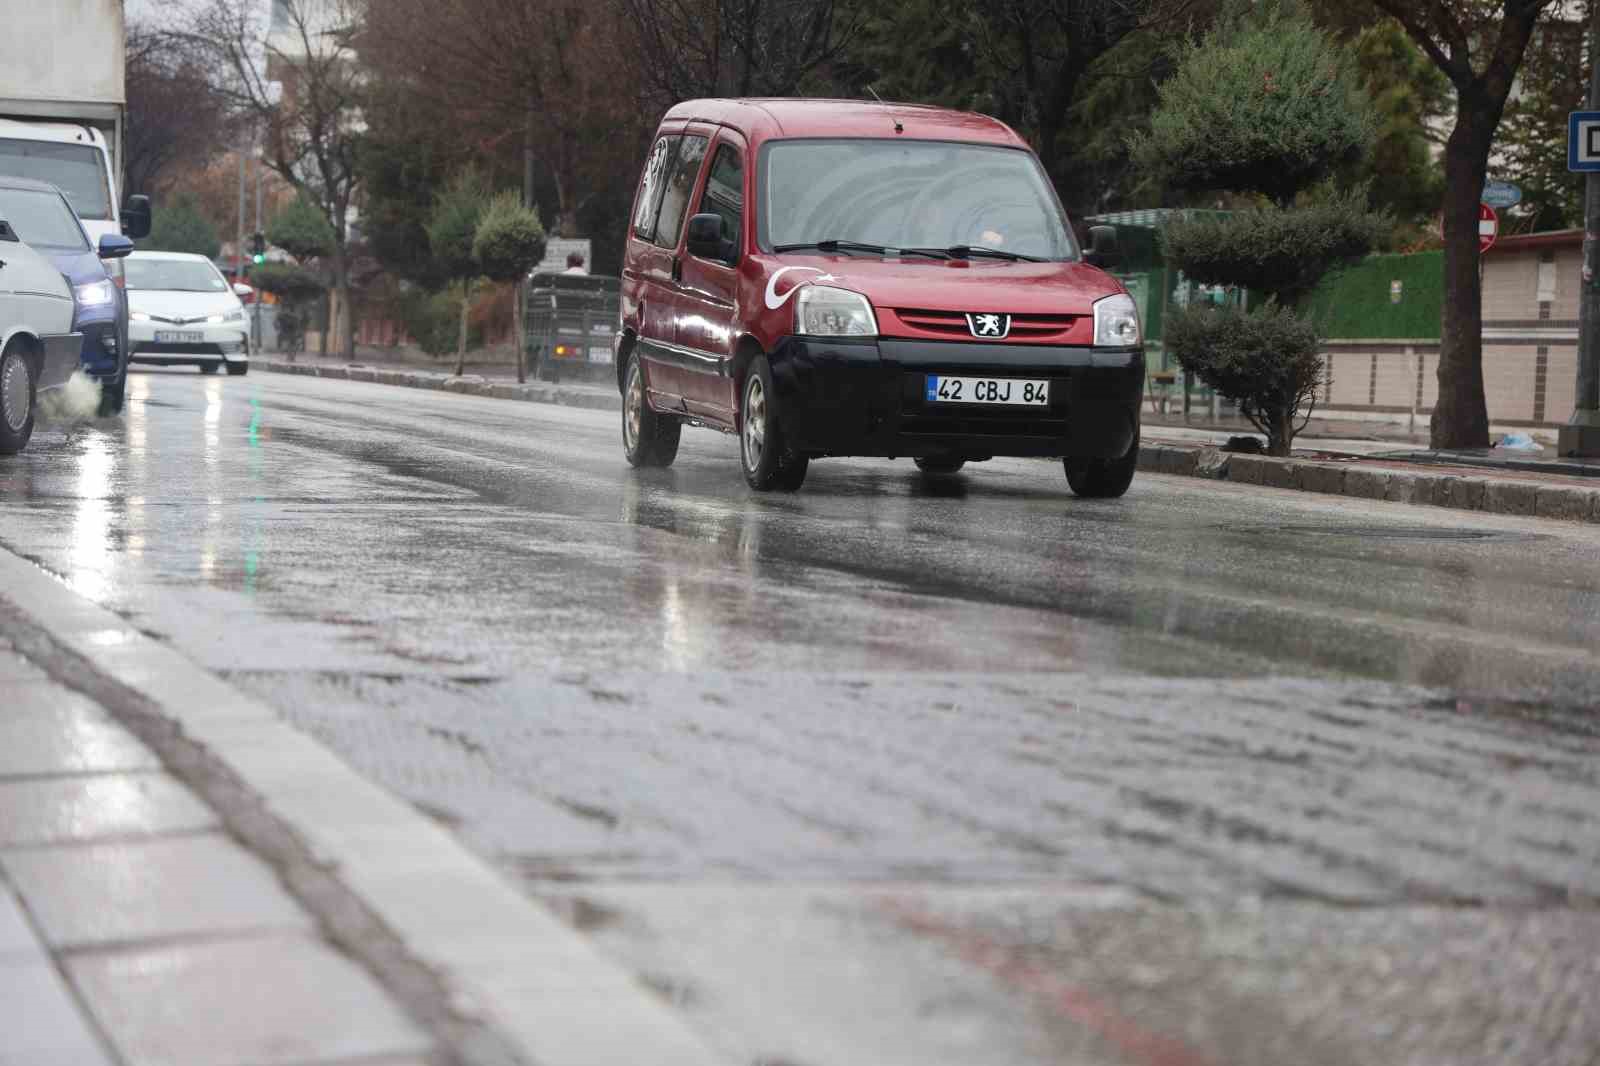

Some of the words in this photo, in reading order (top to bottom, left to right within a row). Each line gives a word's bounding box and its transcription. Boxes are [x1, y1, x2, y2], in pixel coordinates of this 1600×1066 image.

[938, 379, 962, 399] 42
[975, 381, 1011, 402] CBJ
[1023, 383, 1046, 403] 84
